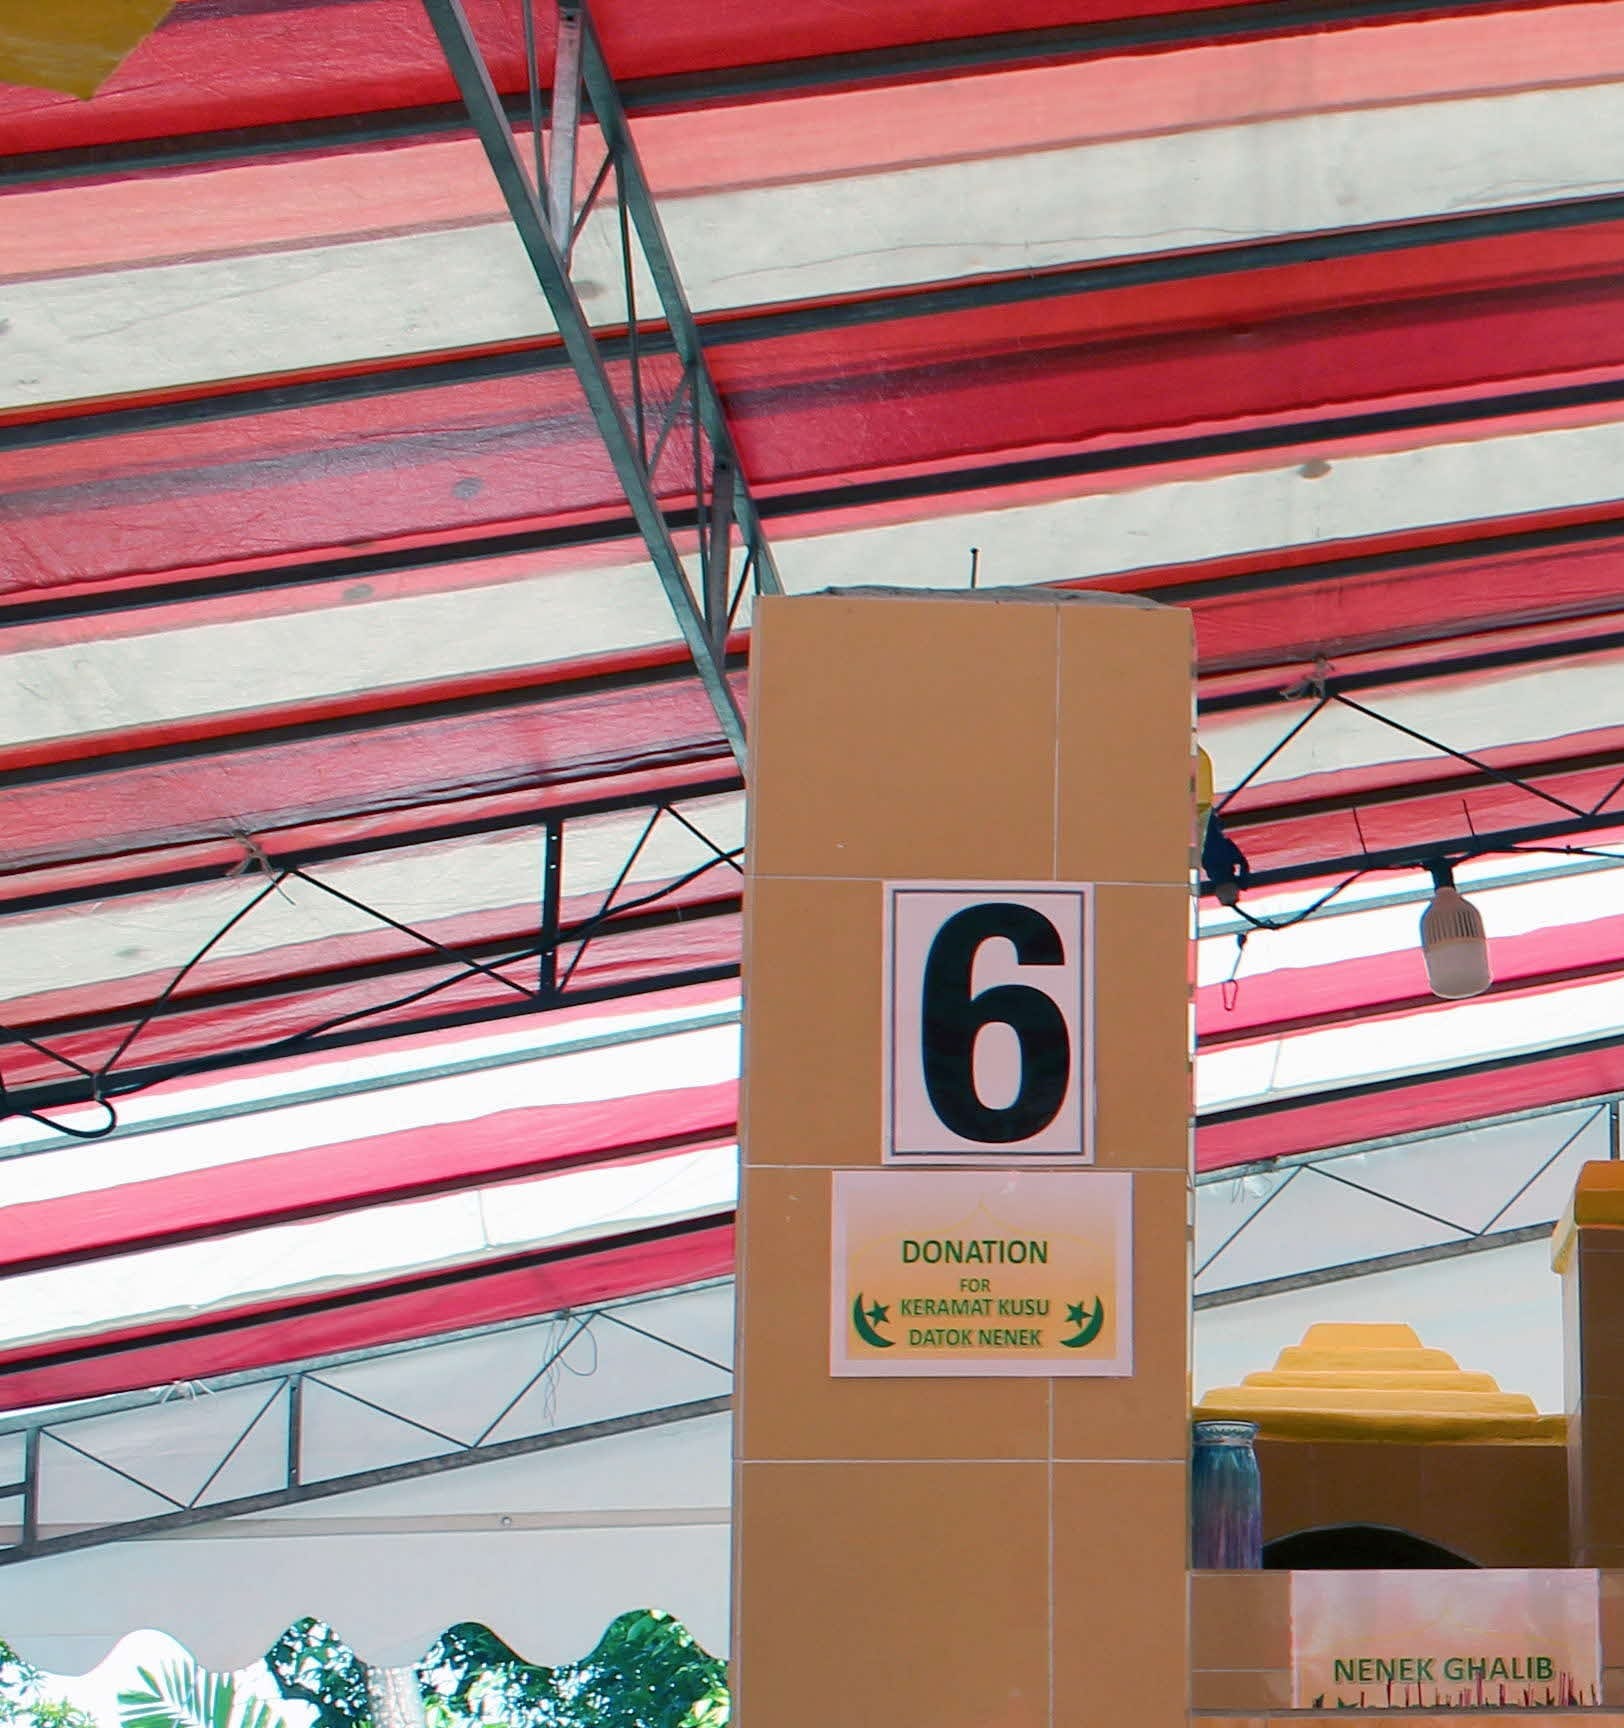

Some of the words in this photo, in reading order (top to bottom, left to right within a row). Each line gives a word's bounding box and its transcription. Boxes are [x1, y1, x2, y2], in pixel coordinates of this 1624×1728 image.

[921, 902, 1070, 1144] 6
[902, 1239, 1049, 1265] DONATION
[960, 1277, 991, 1294] FOR
[900, 1297, 994, 1317] KERAMAT
[998, 1297, 1051, 1317] KUSU
[908, 1328, 974, 1347] DATOK
[977, 1328, 1043, 1347] NENEK
[1333, 1657, 1434, 1682] NENEK
[1443, 1655, 1554, 1681] GHALIB
